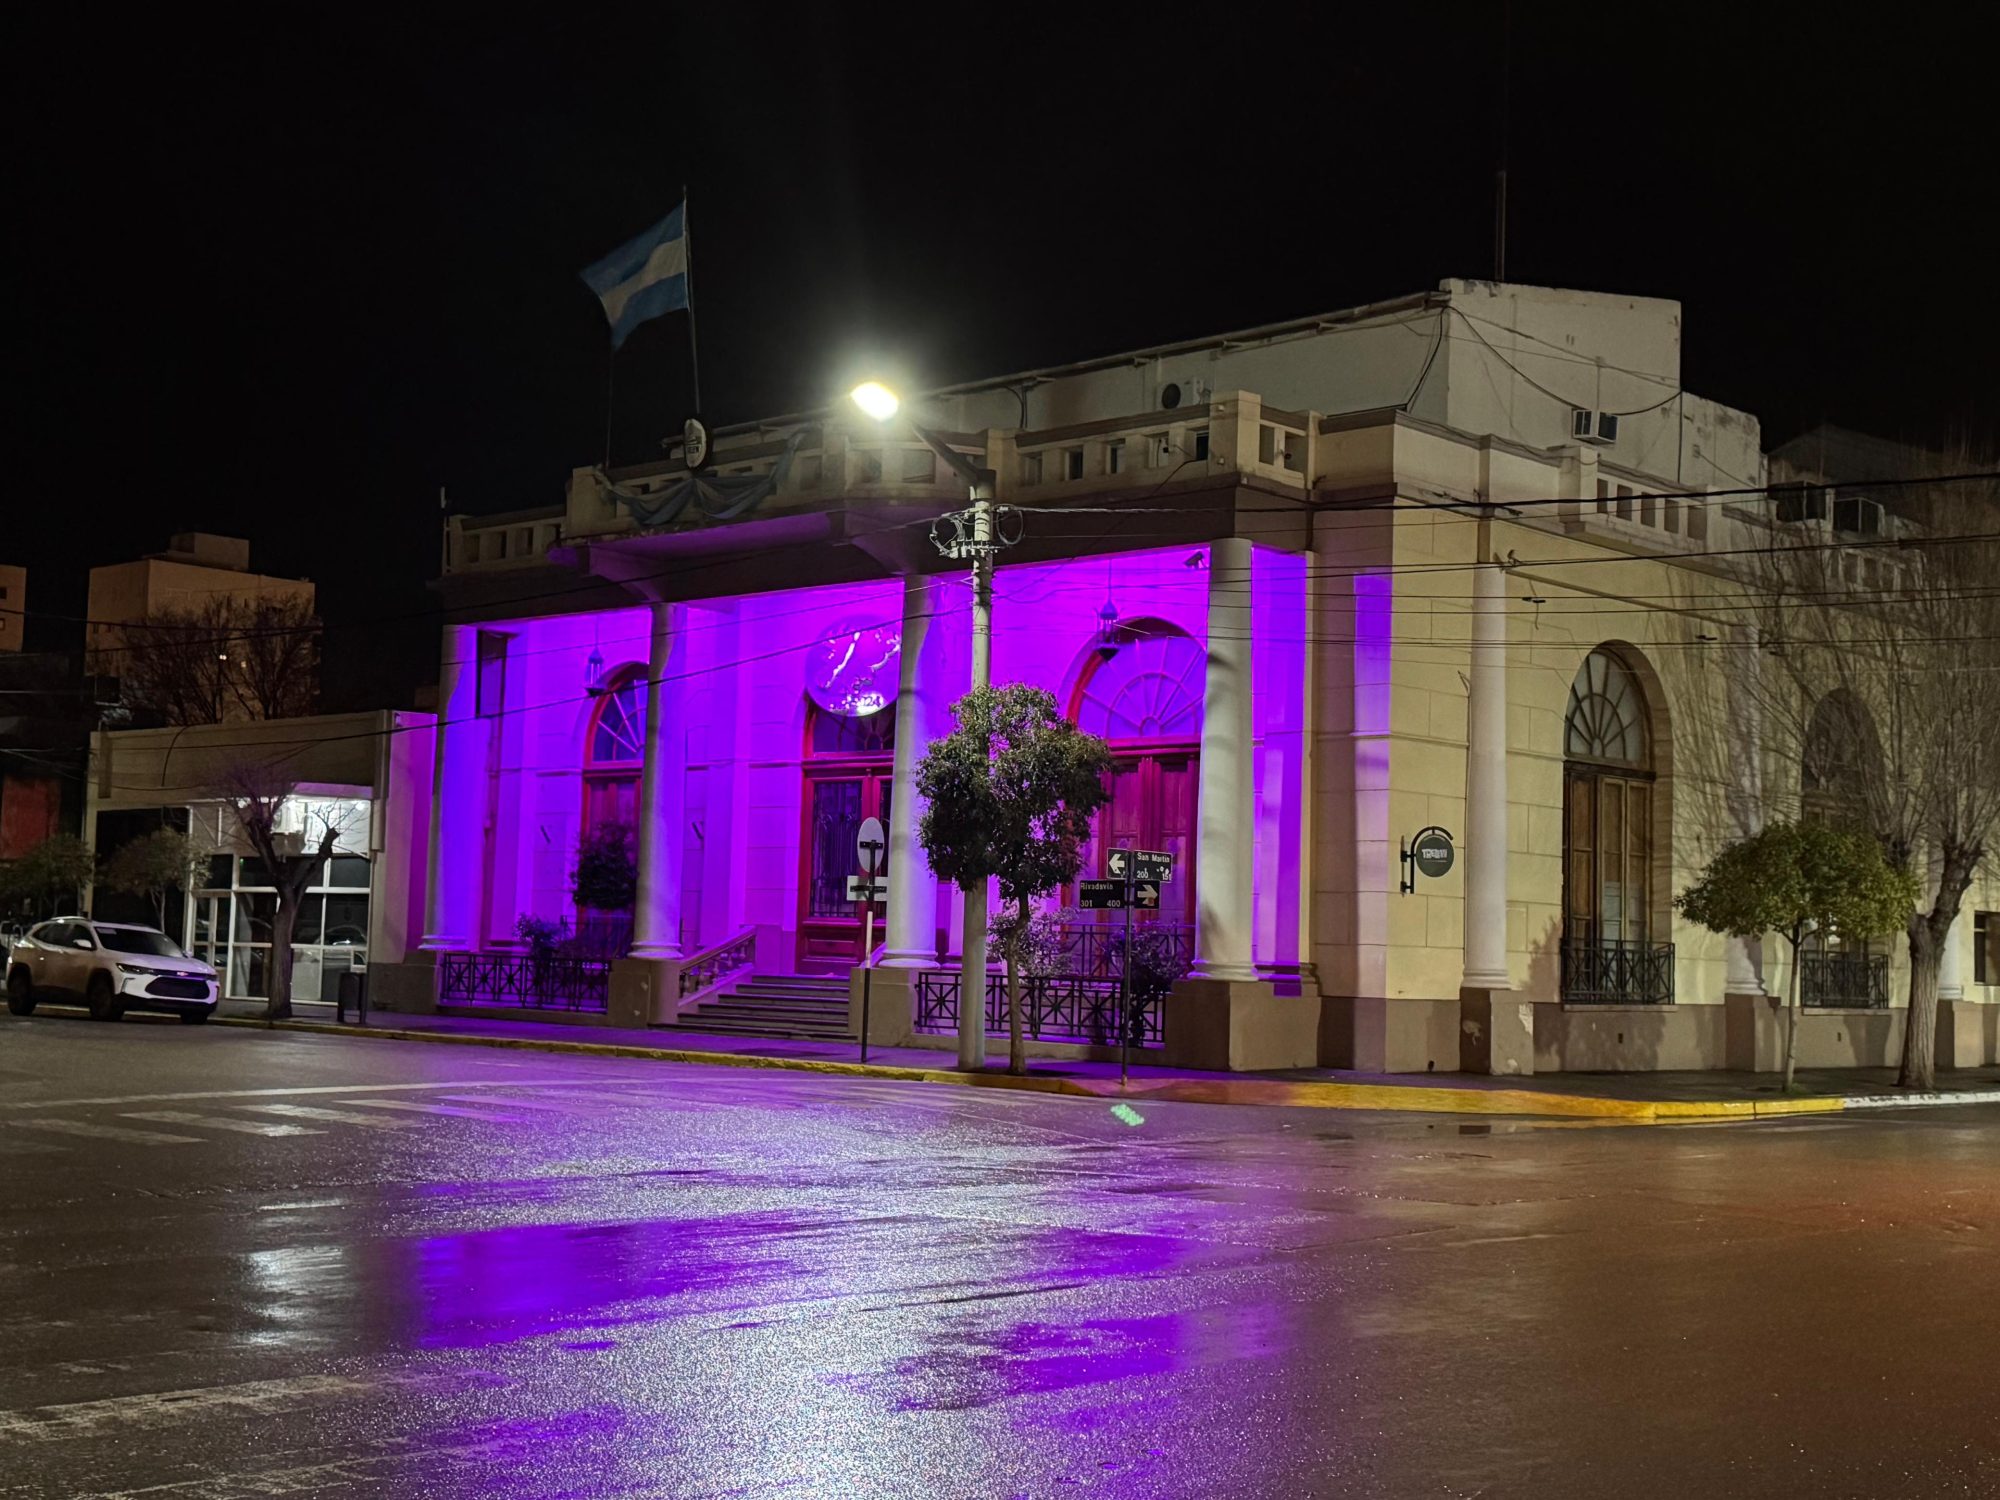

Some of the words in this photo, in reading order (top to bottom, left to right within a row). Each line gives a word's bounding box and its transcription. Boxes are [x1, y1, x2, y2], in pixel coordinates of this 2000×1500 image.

[1137, 852, 1150, 861] San
[1136, 870, 1149, 879] 200
[1080, 882, 1114, 890] Rivadavia
[1080, 899, 1093, 908] 301
[1106, 899, 1121, 907] 400
